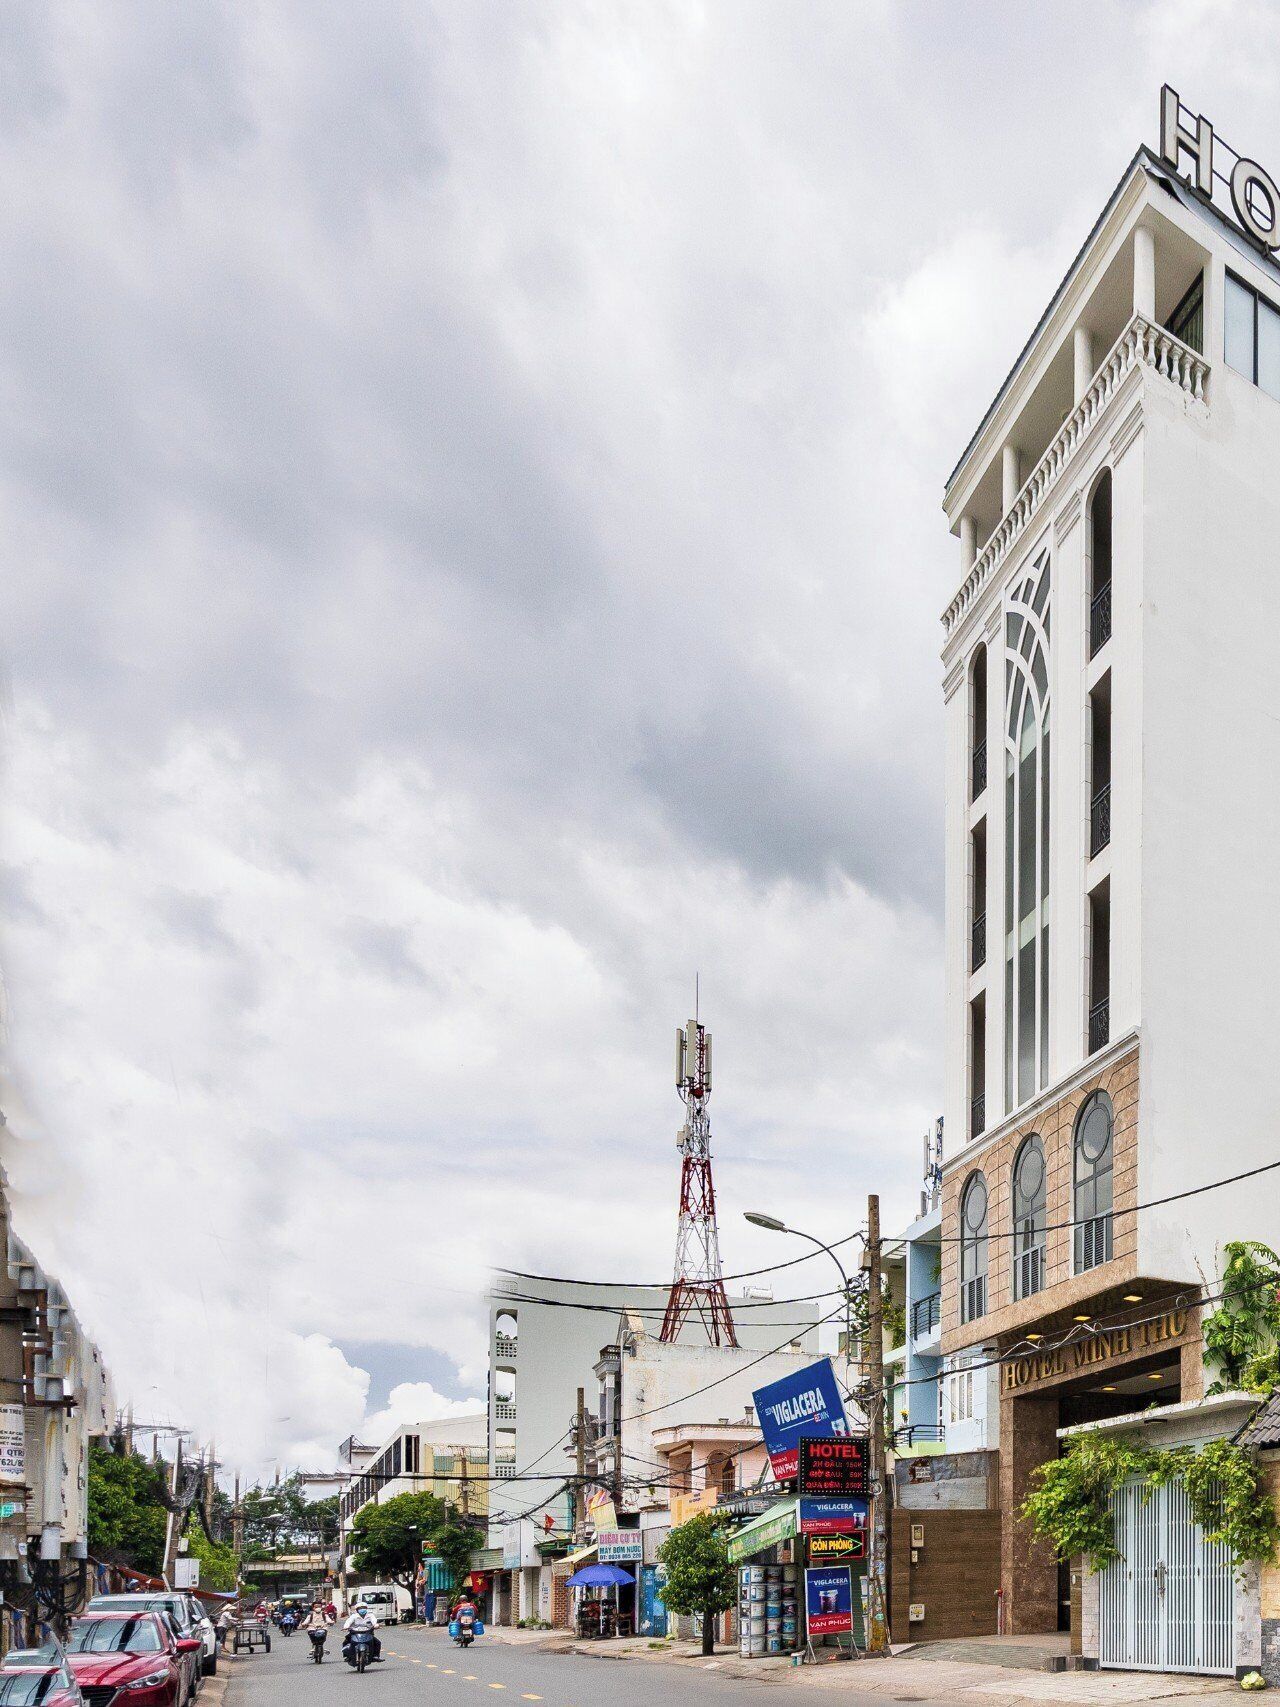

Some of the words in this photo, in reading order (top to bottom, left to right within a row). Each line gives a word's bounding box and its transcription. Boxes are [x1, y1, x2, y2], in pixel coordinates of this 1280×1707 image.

[1004, 1354, 1066, 1390] HOTEL
[1074, 1329, 1130, 1367] MINH
[771, 1387, 827, 1425] VIGLACERA
[809, 1444, 861, 1458] HOTEL
[816, 1503, 854, 1511] VIGLACERA
[811, 1539, 828, 1551] CÒN
[829, 1538, 853, 1550] PHÒNG
[813, 1577, 849, 1586] VIGLACERA
